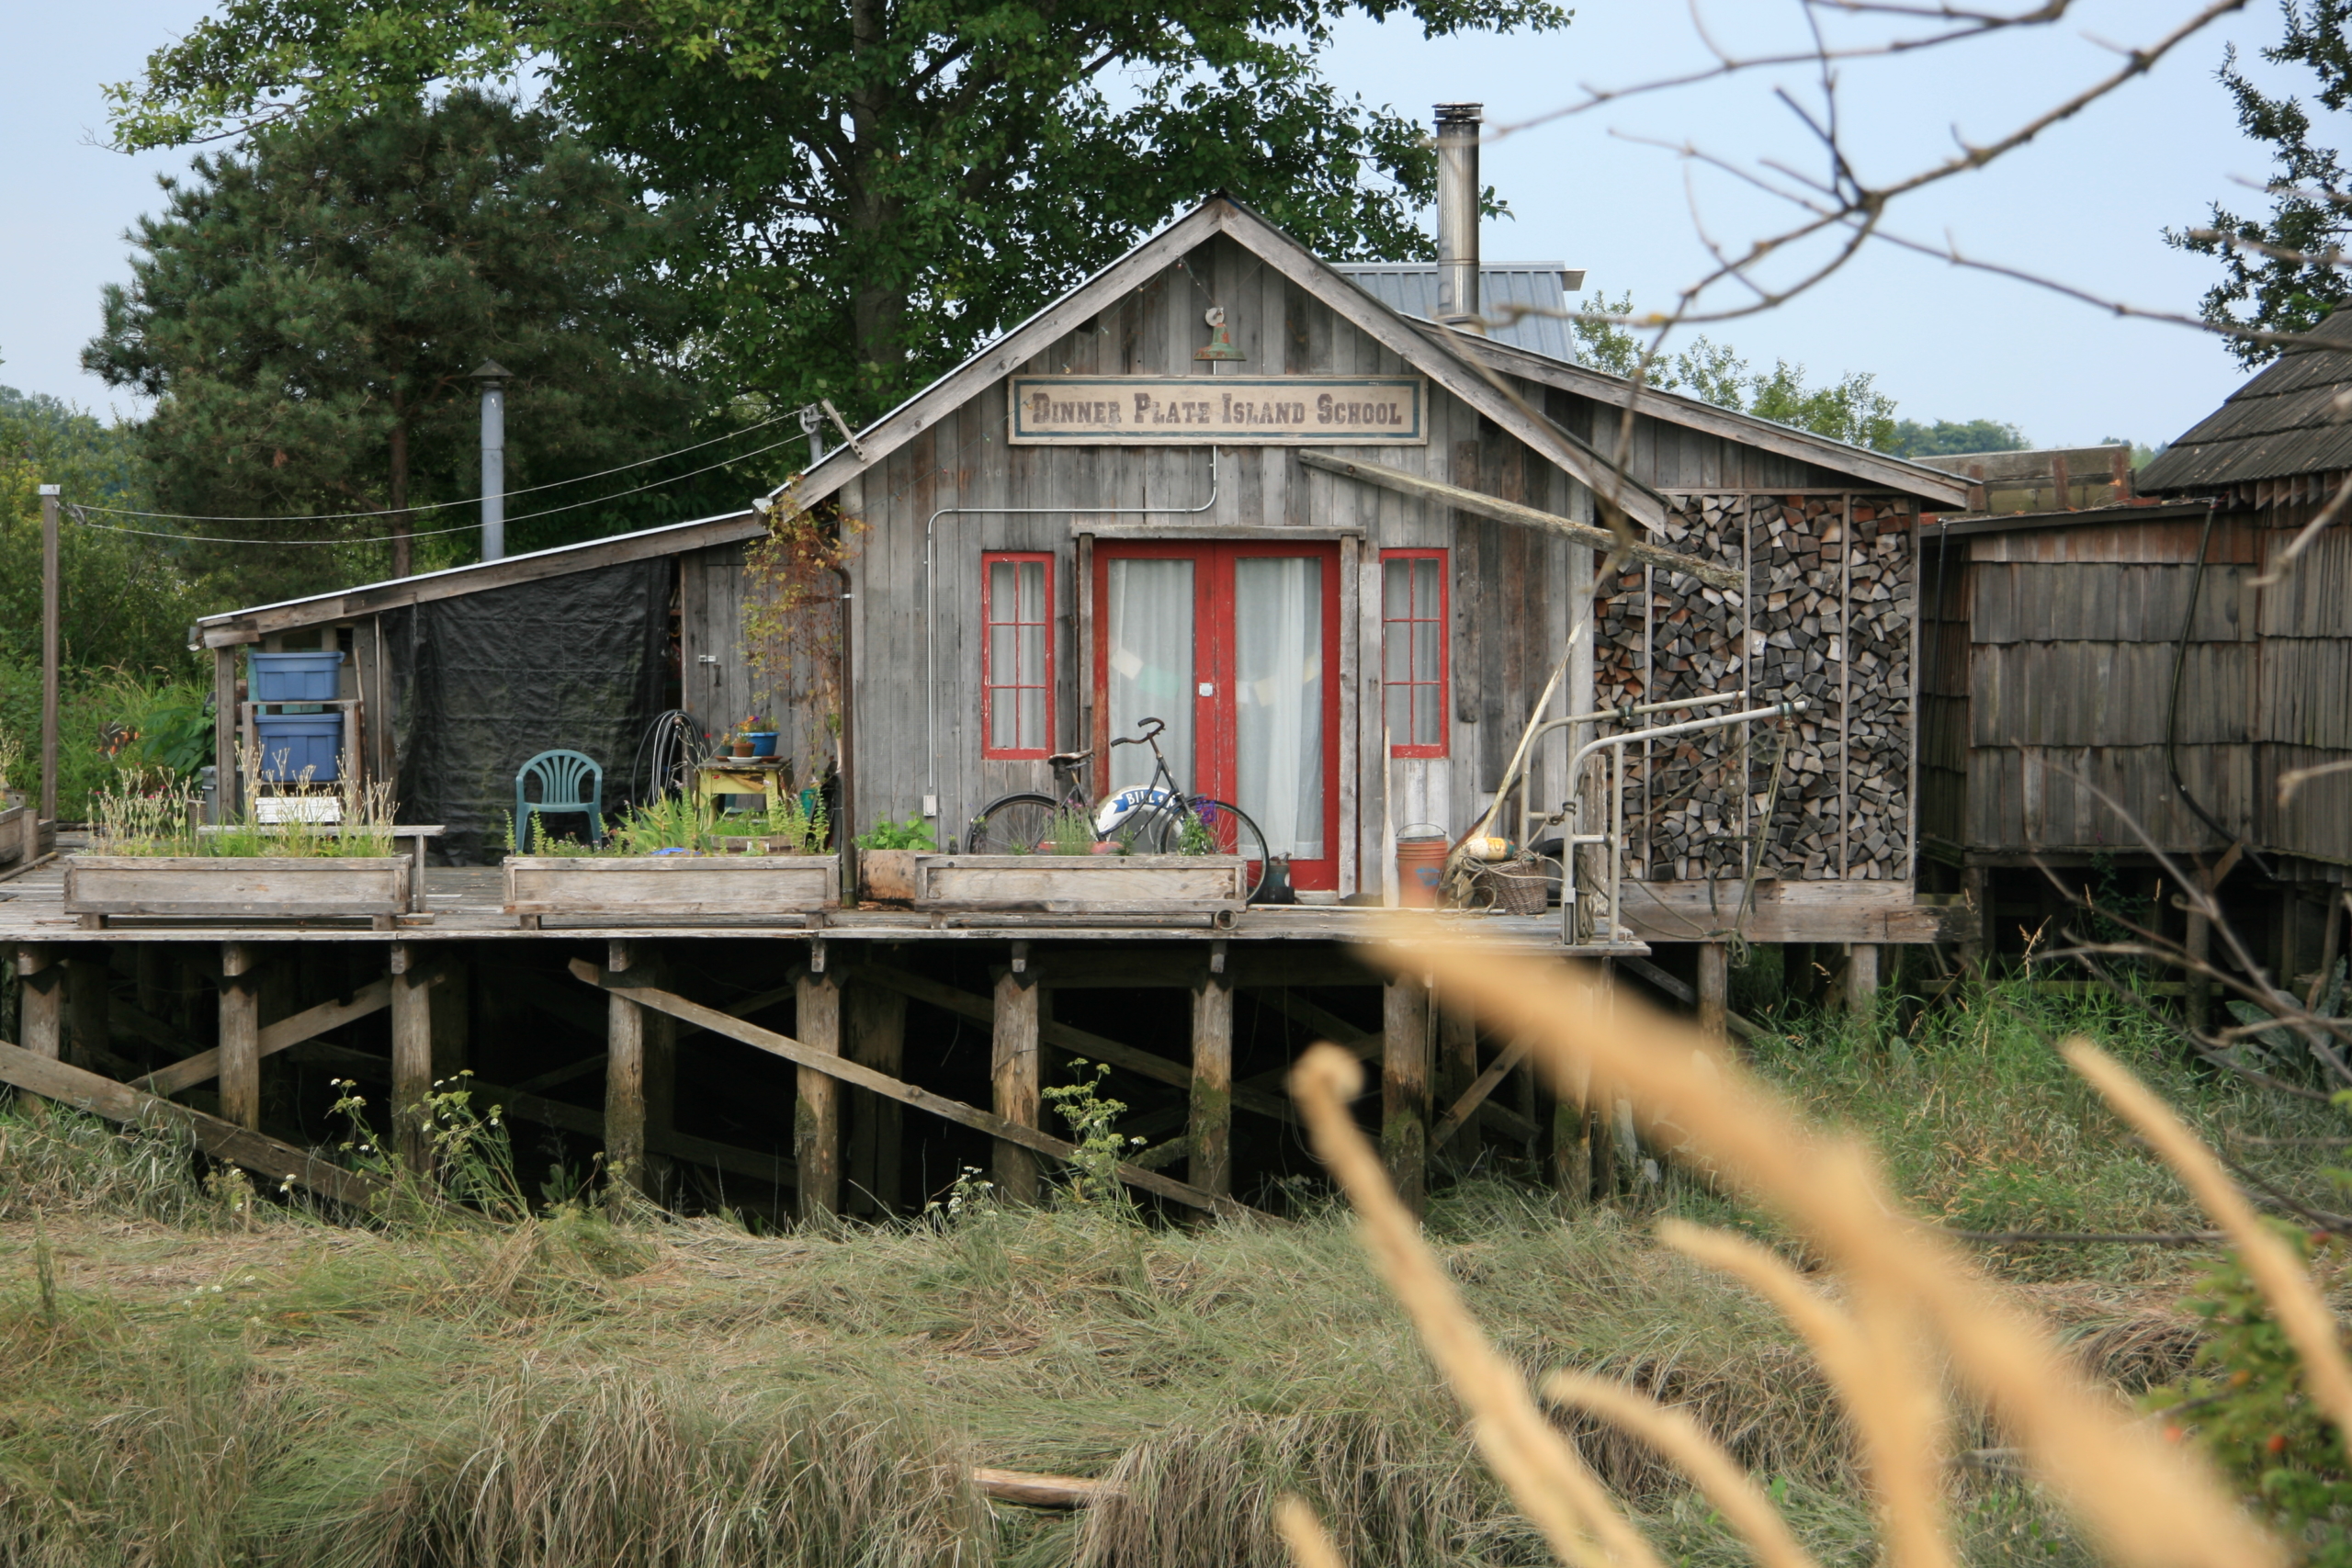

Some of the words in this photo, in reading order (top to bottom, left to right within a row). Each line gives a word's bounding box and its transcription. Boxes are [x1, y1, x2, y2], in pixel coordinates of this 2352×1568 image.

[1032, 392, 1122, 424] DINNER
[1134, 392, 1211, 424] PLATE
[1221, 392, 1306, 424] ISLAND
[1317, 393, 1403, 425] SCHOOL
